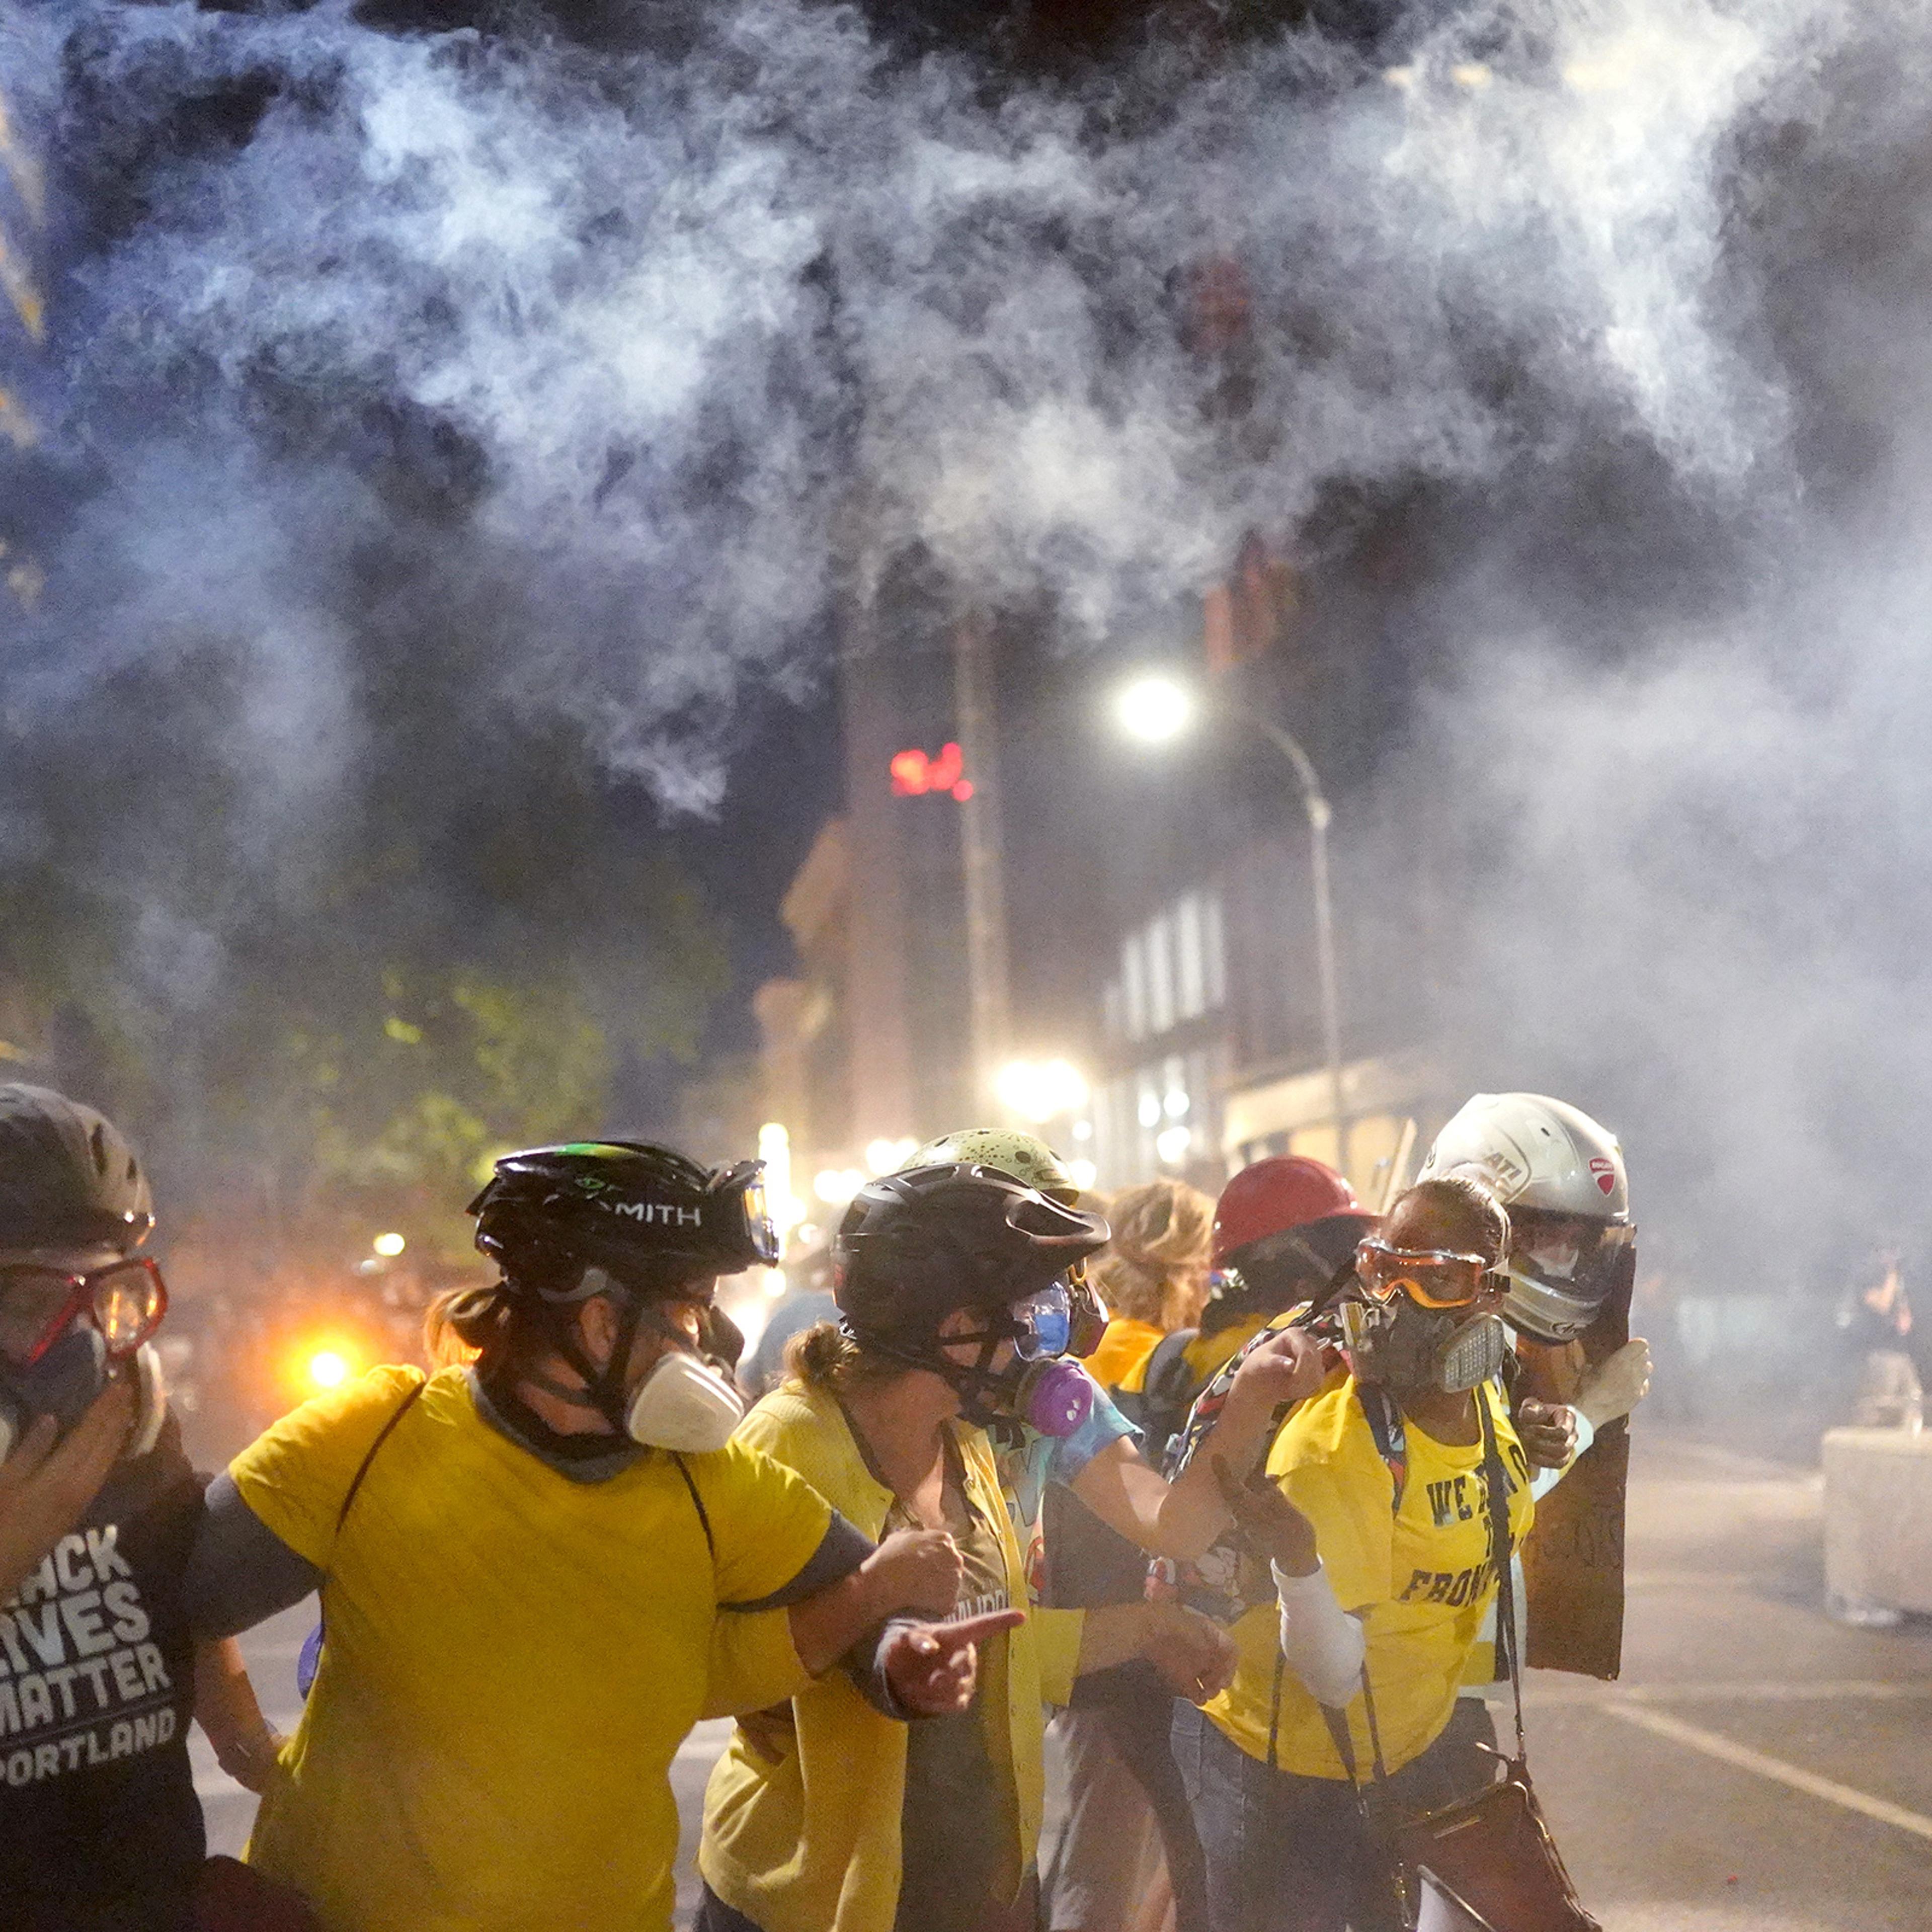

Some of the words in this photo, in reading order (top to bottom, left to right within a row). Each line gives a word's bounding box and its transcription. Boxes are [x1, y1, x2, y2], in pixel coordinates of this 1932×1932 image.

[599, 1200, 701, 1227] MITH
[6, 1524, 132, 1607] ACK
[0, 1582, 150, 1677] IVES
[0, 1708, 176, 1786] ORTLAND
